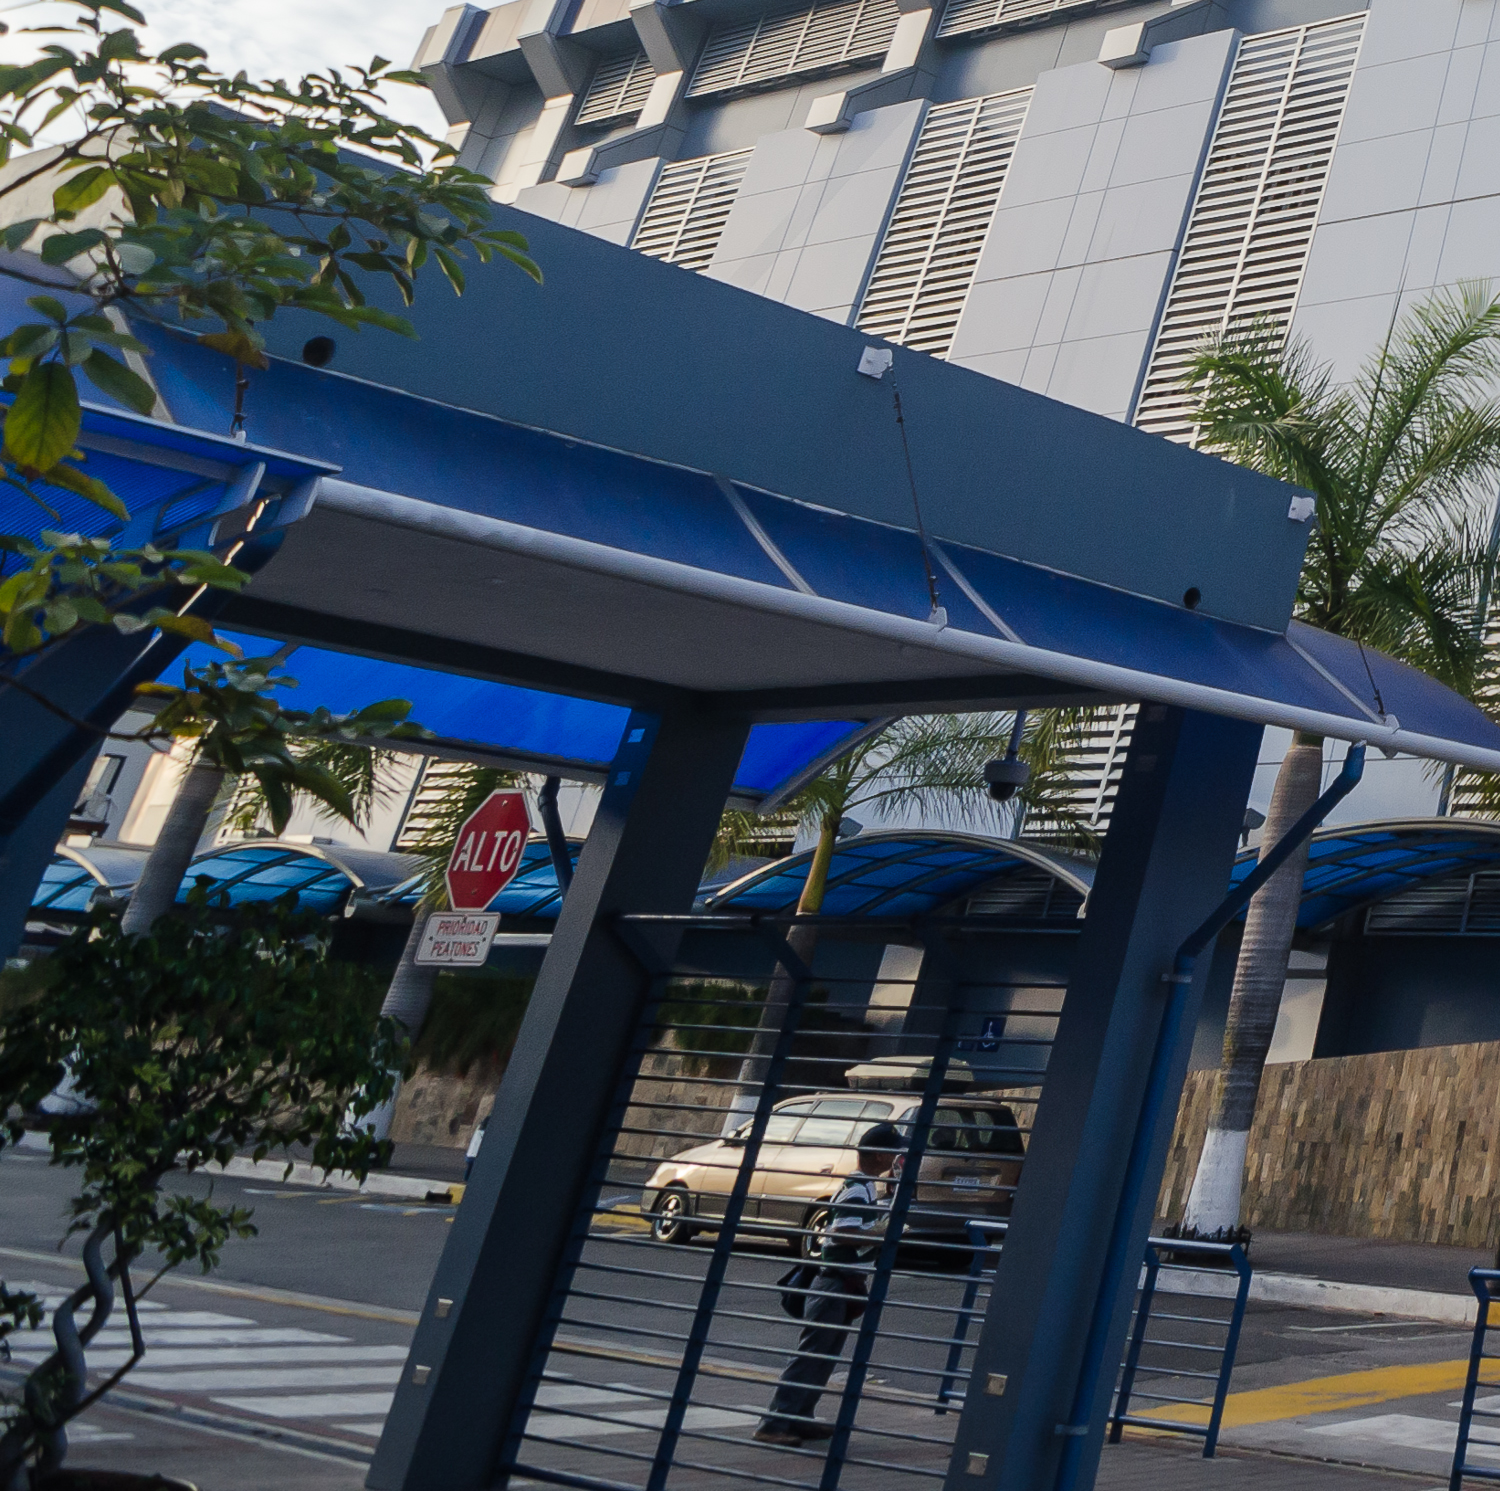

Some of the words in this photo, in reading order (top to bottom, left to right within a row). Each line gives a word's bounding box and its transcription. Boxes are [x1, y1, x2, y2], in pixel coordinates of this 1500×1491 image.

[453, 830, 522, 872] ALTO
[436, 920, 488, 936] PRIORIDAD
[430, 941, 480, 957] PEATONES
